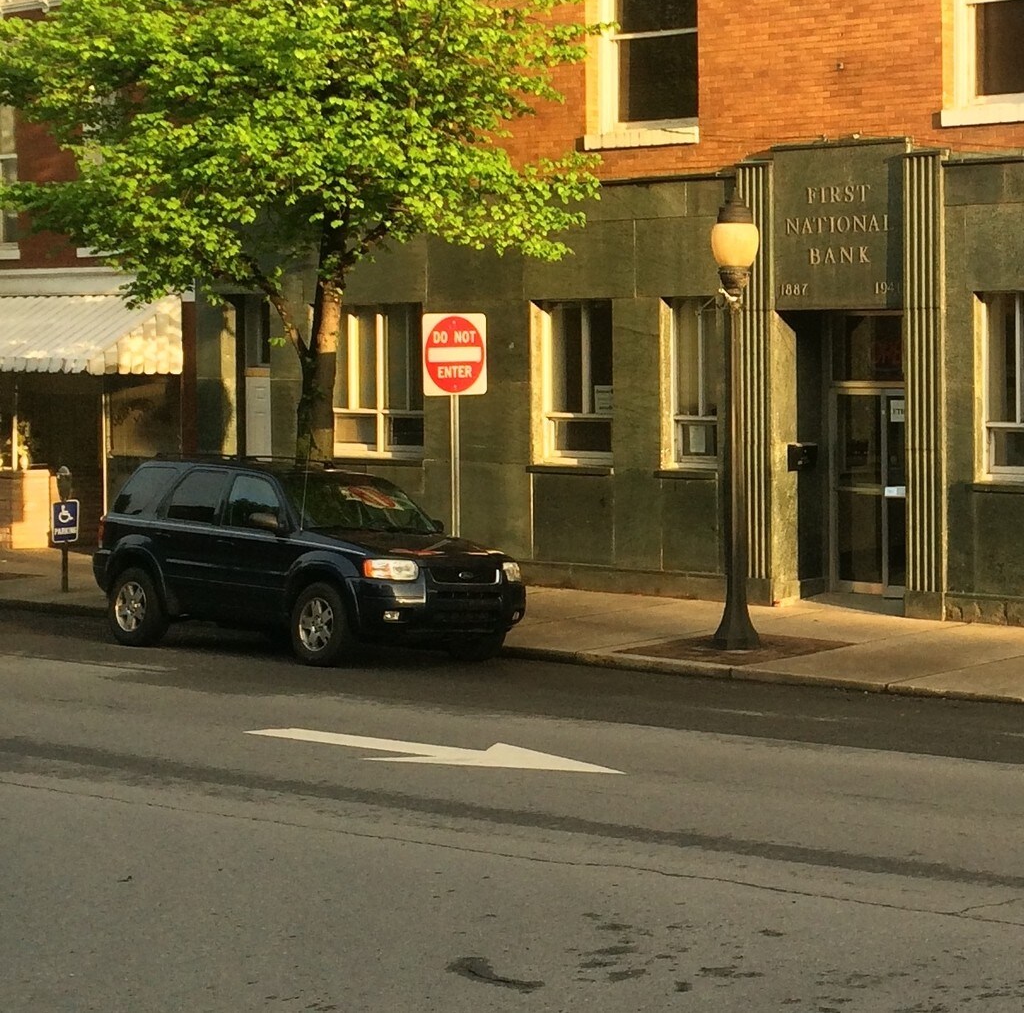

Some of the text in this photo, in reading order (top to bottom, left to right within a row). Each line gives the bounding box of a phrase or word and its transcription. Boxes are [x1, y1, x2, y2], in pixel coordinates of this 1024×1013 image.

[807, 185, 871, 203] FIRST
[786, 214, 893, 235] NATIONAL
[809, 247, 871, 265] BANK
[781, 284, 808, 296] 1887
[433, 330, 476, 344] DO NOT
[437, 365, 473, 379] ENTER
[54, 527, 77, 535] PARKING
